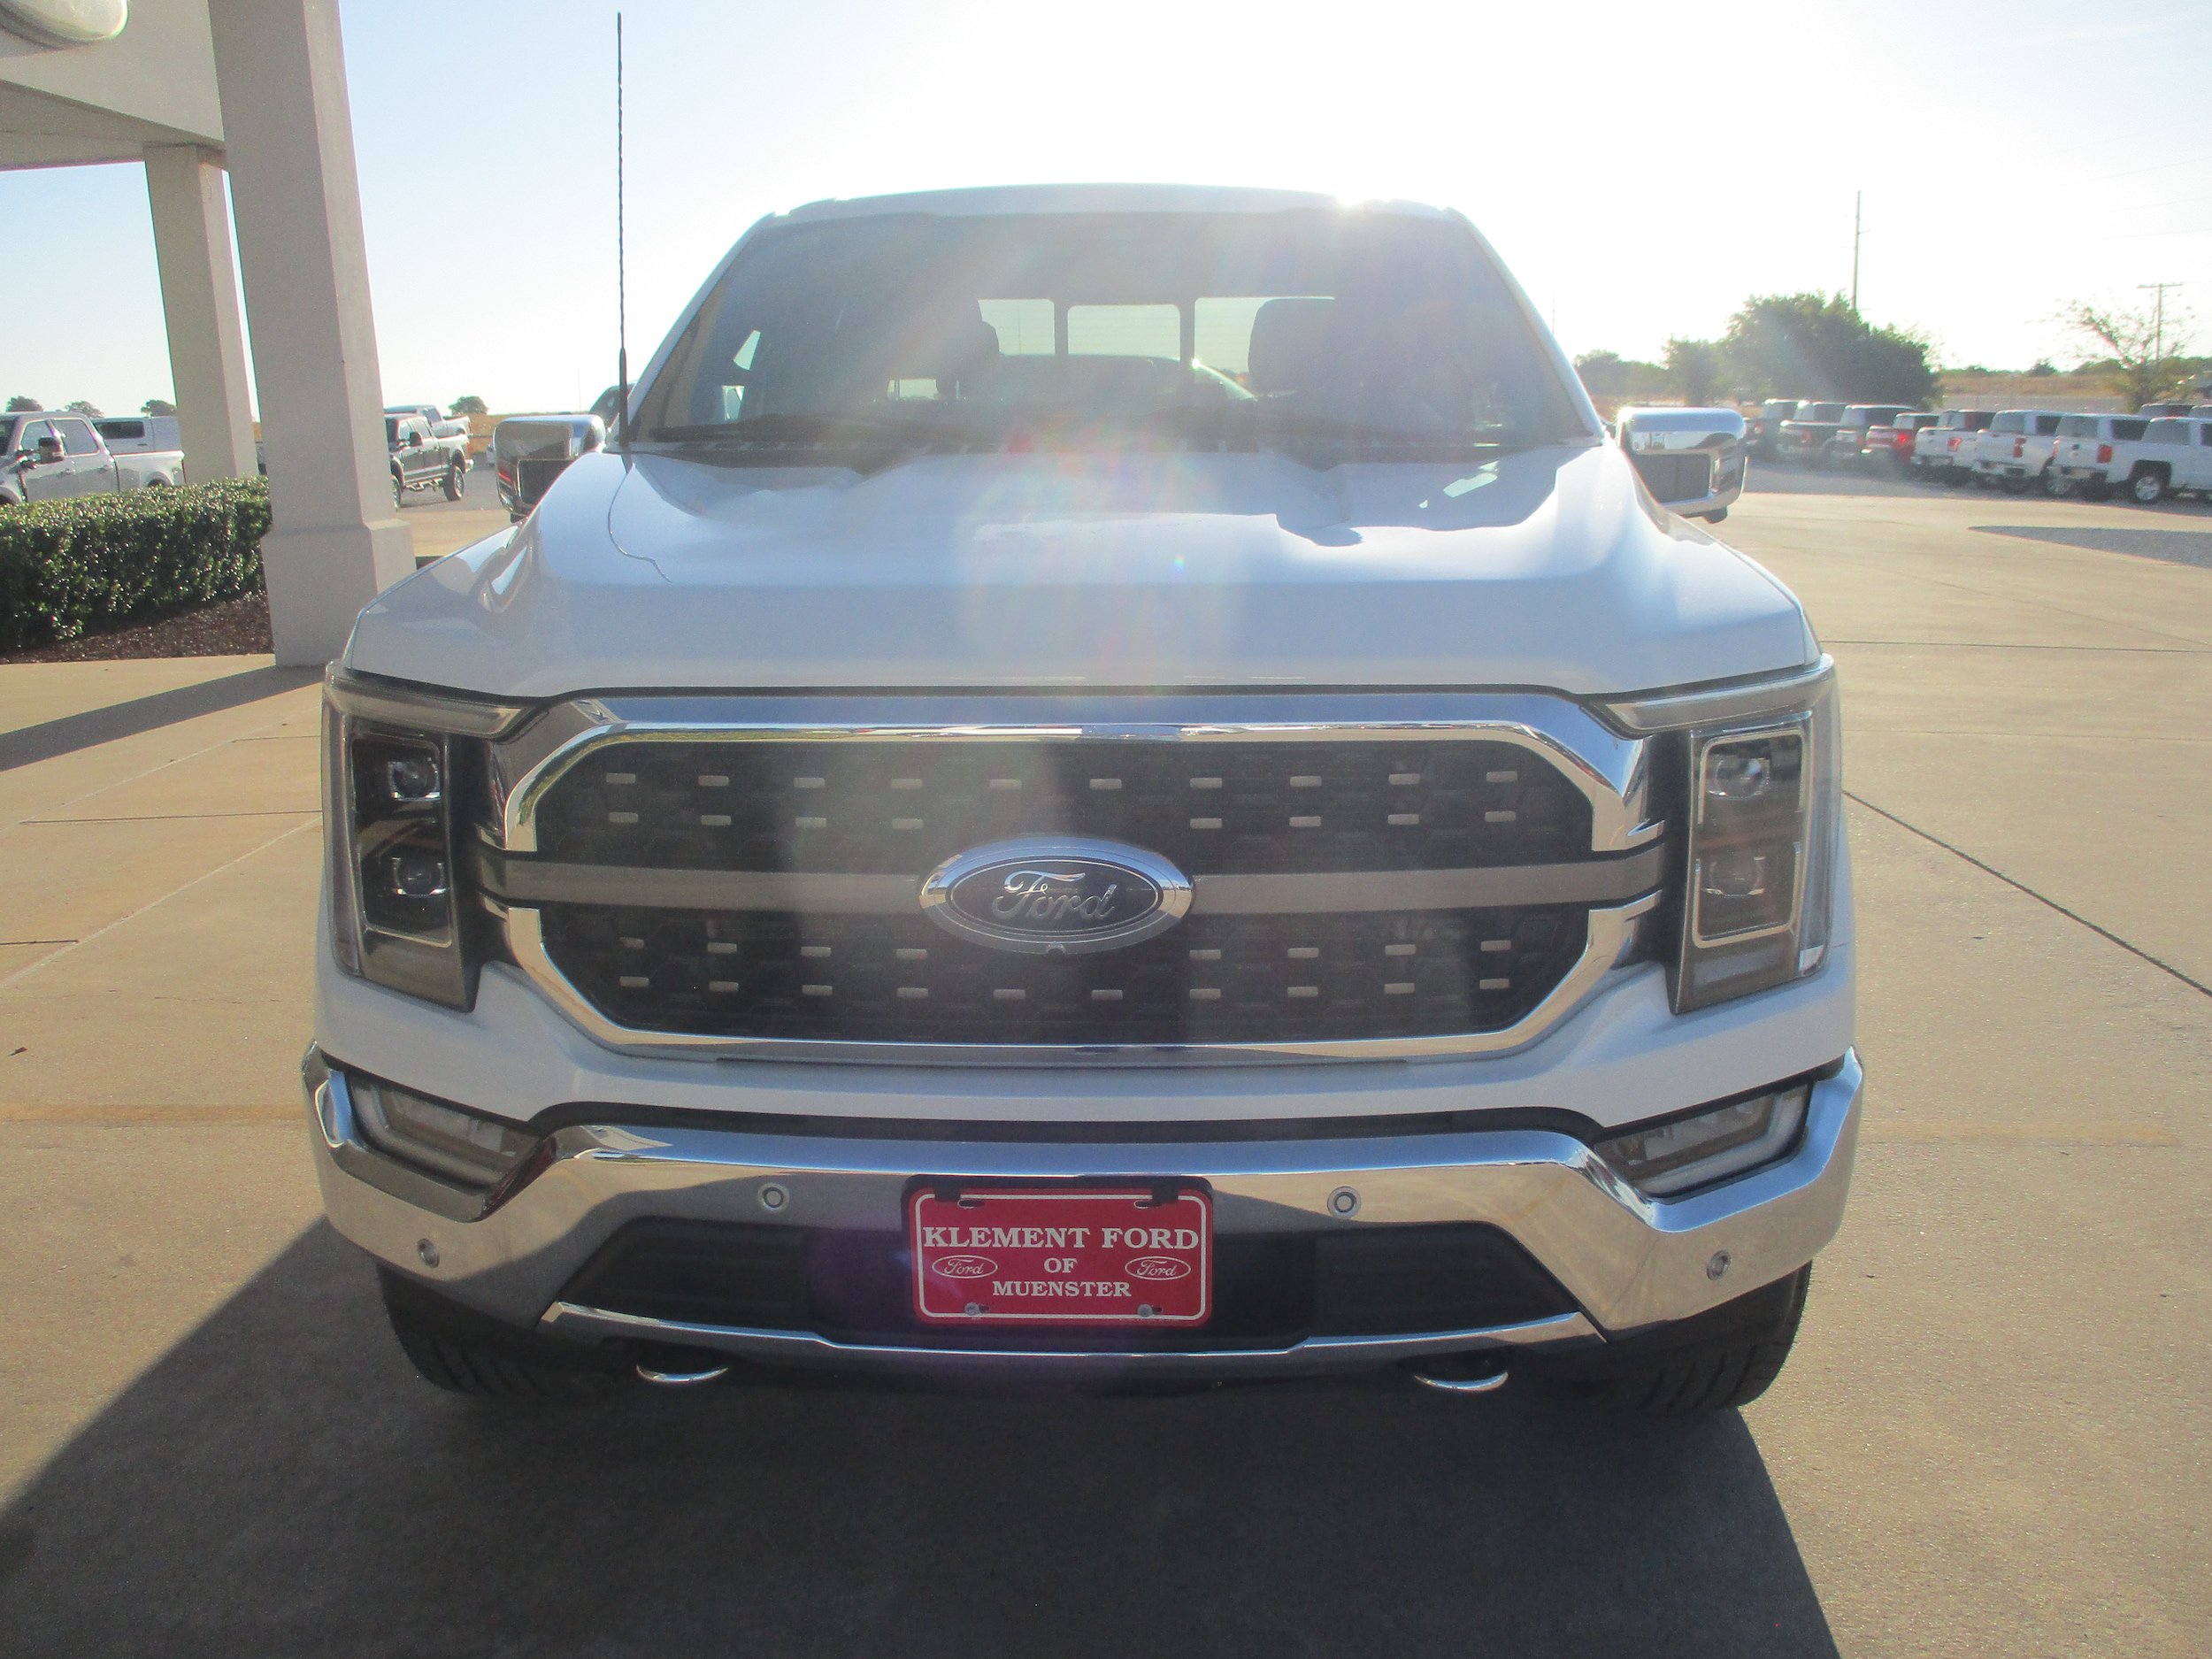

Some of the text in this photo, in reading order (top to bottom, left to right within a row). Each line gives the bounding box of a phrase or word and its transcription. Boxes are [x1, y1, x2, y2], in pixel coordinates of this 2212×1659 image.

[992, 870, 1118, 920] Ford
[923, 1226, 1199, 1250] KLEMENT FORD
[943, 1258, 984, 1276] Ford
[1044, 1257, 1077, 1273] OF
[1136, 1259, 1177, 1277] Ford
[992, 1281, 1132, 1297] MUENSTER
